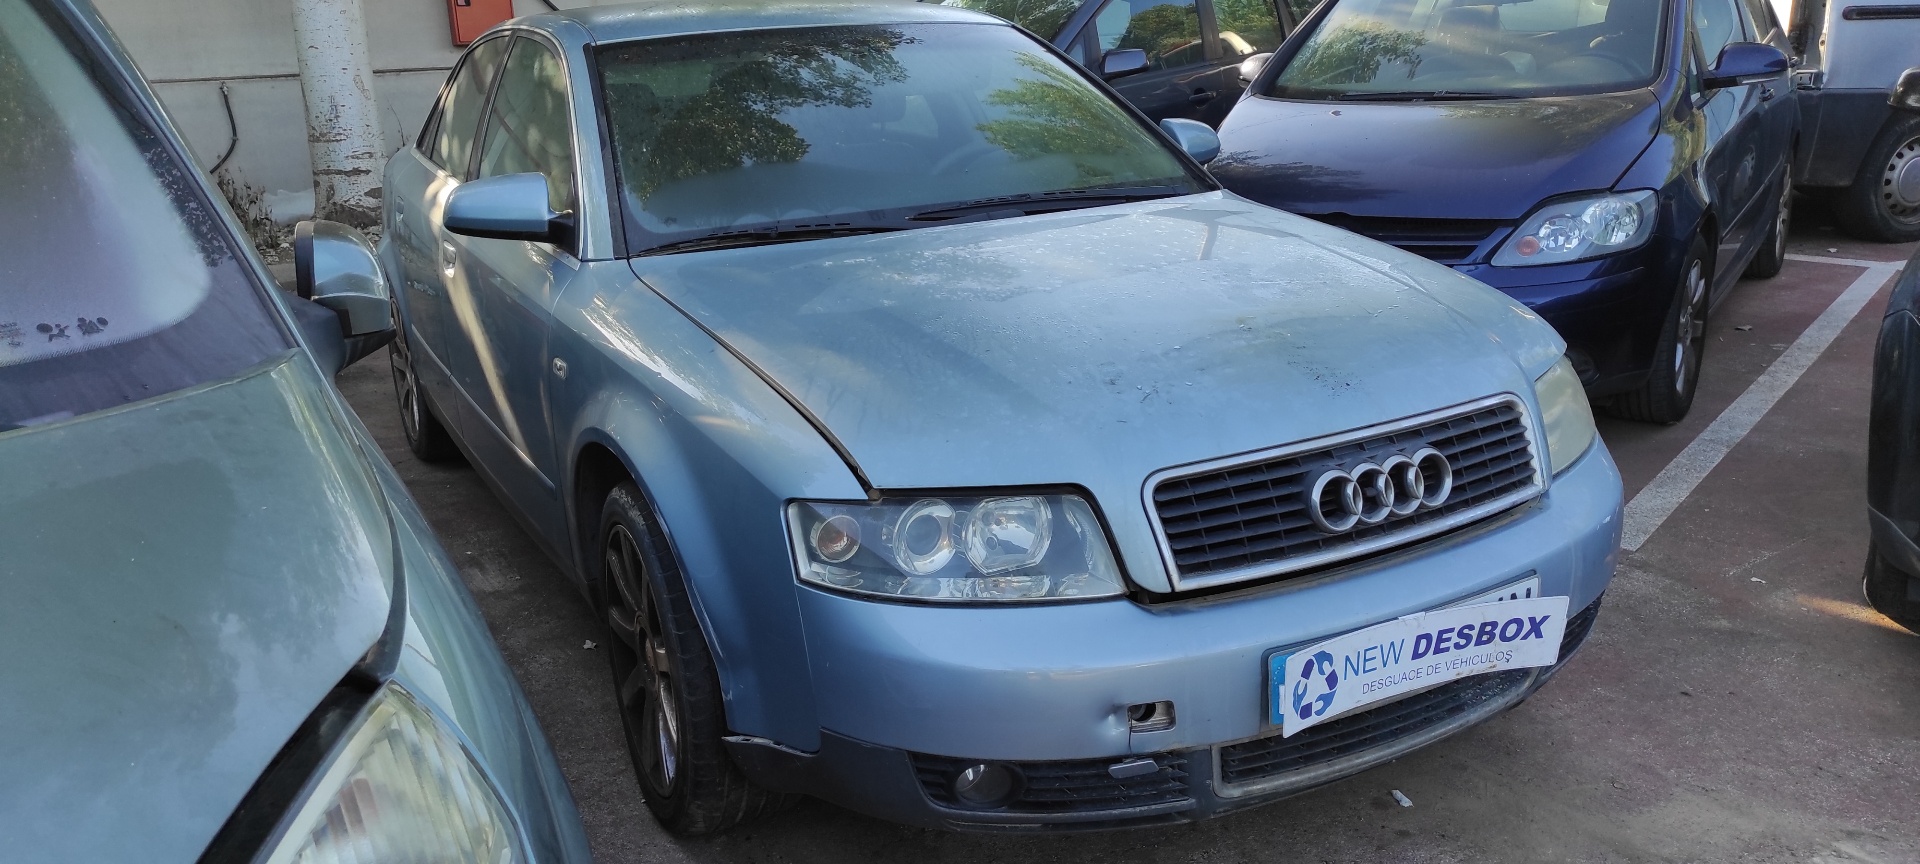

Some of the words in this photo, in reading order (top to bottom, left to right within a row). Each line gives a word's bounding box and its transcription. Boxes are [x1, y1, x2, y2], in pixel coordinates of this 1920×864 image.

[1344, 639, 1404, 680] NEW
[1411, 615, 1551, 660] DESBOX
[1362, 668, 1423, 694] DESGUACE
[1426, 664, 1442, 676] DE
[1445, 650, 1513, 671] VEHICULOS
